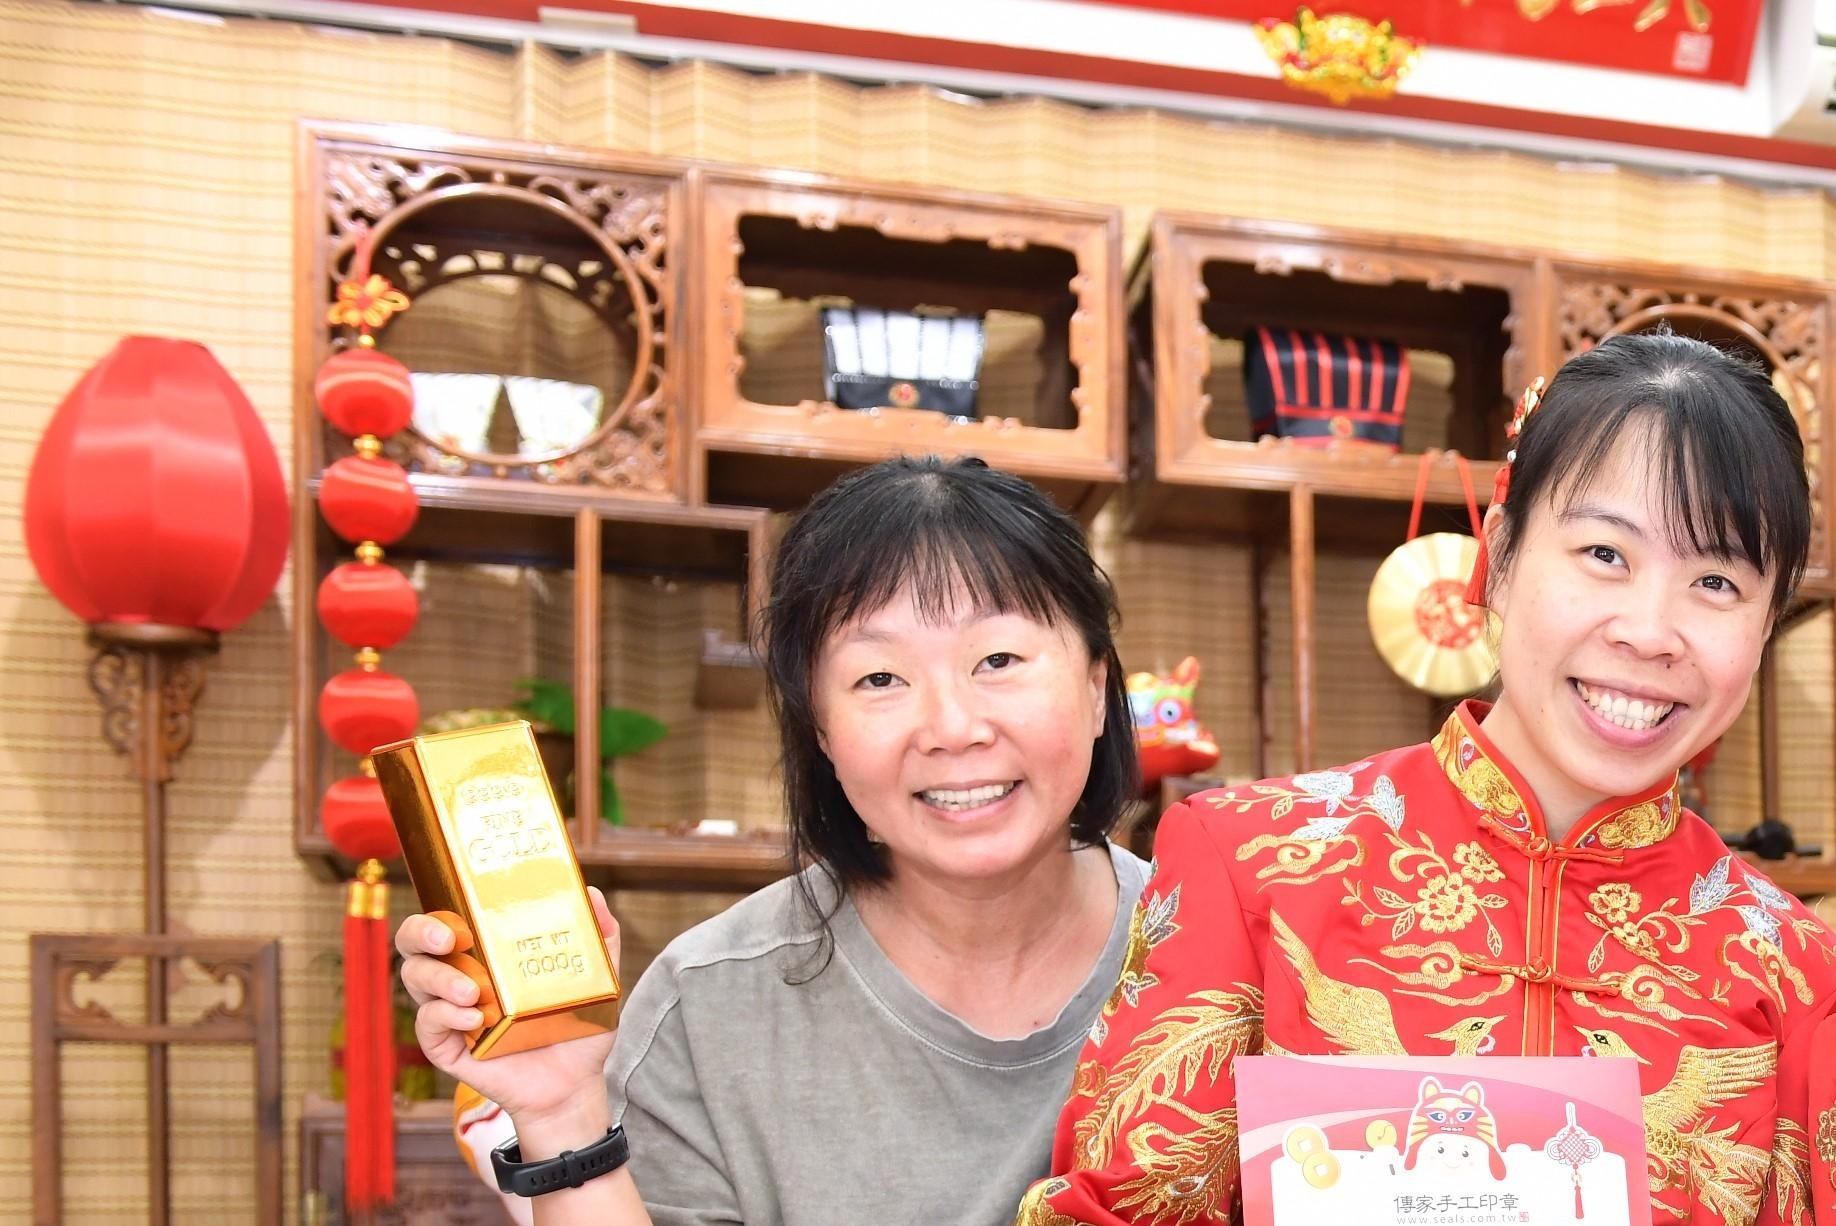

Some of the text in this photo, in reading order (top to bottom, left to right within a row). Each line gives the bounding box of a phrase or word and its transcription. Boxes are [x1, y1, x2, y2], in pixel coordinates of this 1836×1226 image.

[468, 825, 552, 863] GOLD
[517, 952, 585, 979] 1000g
[1393, 1192, 1519, 1214] 傳家手工印章
[1396, 1213, 1517, 1225] www.seals.com.tw
